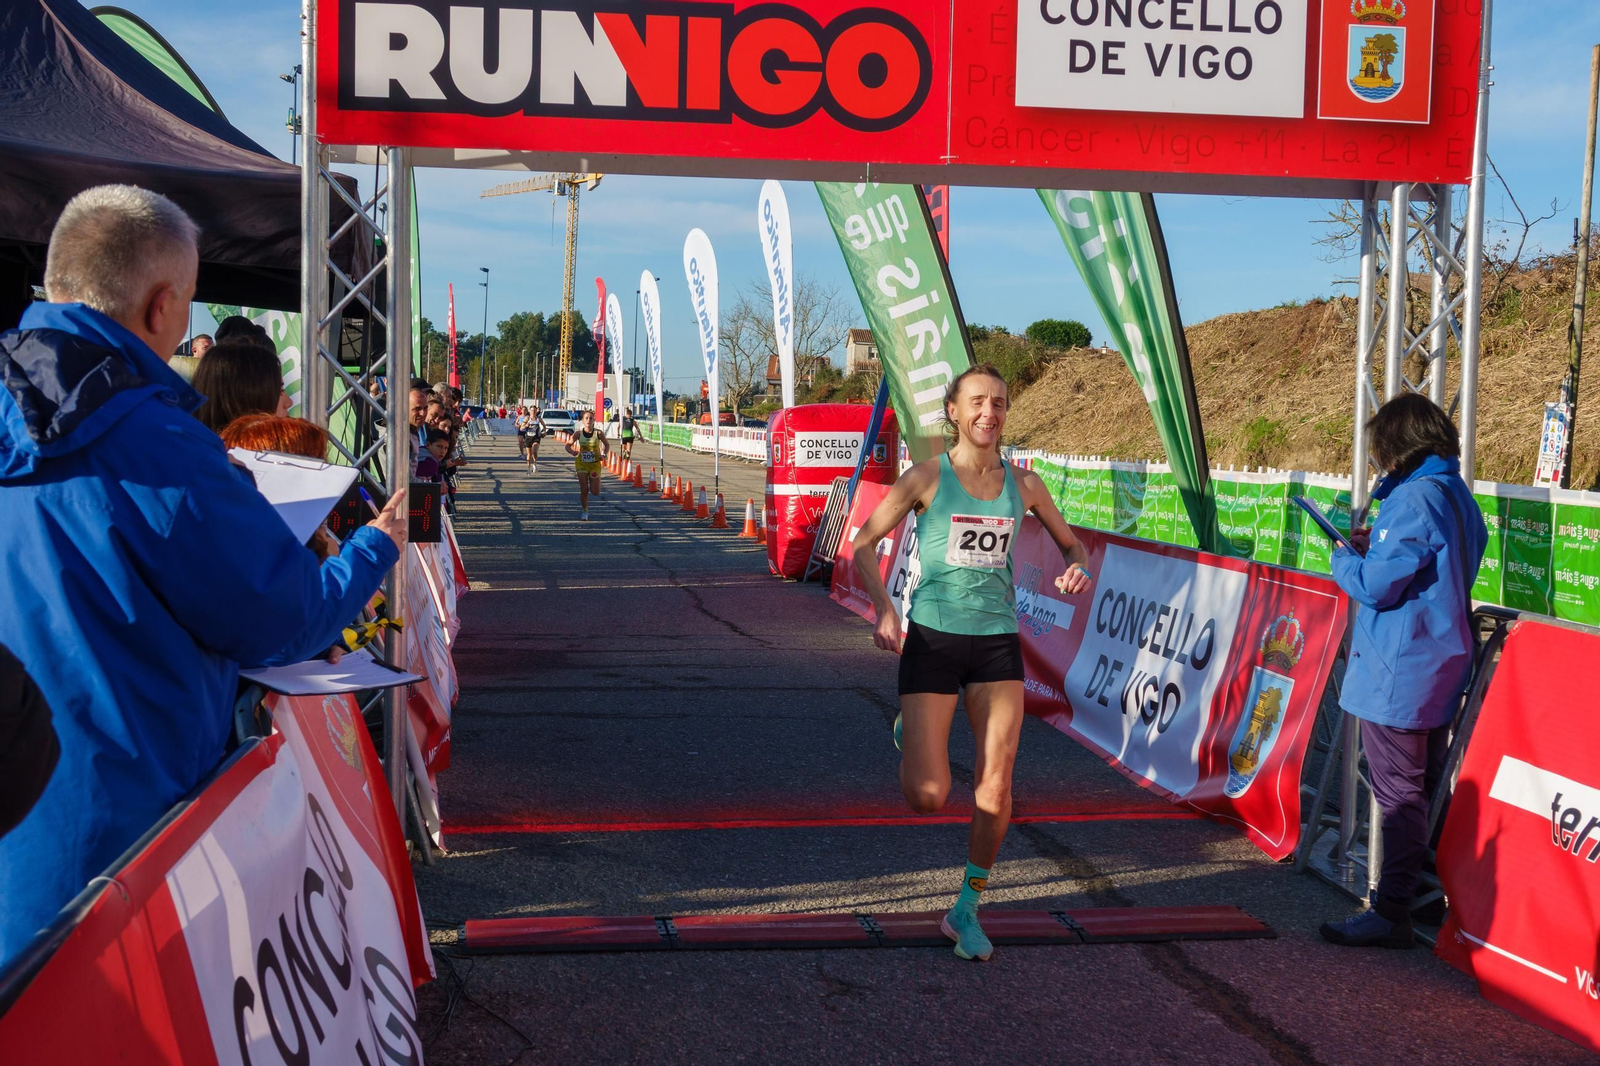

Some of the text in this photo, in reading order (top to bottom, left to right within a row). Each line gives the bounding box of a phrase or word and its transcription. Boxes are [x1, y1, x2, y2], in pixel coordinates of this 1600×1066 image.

[1039, 0, 1283, 35] CONCELLO
[1068, 38, 1254, 81] DE VIGO
[964, 116, 1100, 154] Cáncer
[1133, 123, 1217, 164] Vigo
[1321, 132, 1361, 165] La
[1377, 131, 1412, 166] 21
[799, 439, 859, 449] CONCELLO
[806, 450, 852, 460] DE VIGO
[960, 529, 1012, 553] 201
[1558, 521, 1577, 538] máis
[1555, 567, 1574, 584] máis
[1579, 574, 1600, 590] auga
[1096, 587, 1216, 671] CONCELLO
[1084, 653, 1181, 734] DE VIGO
